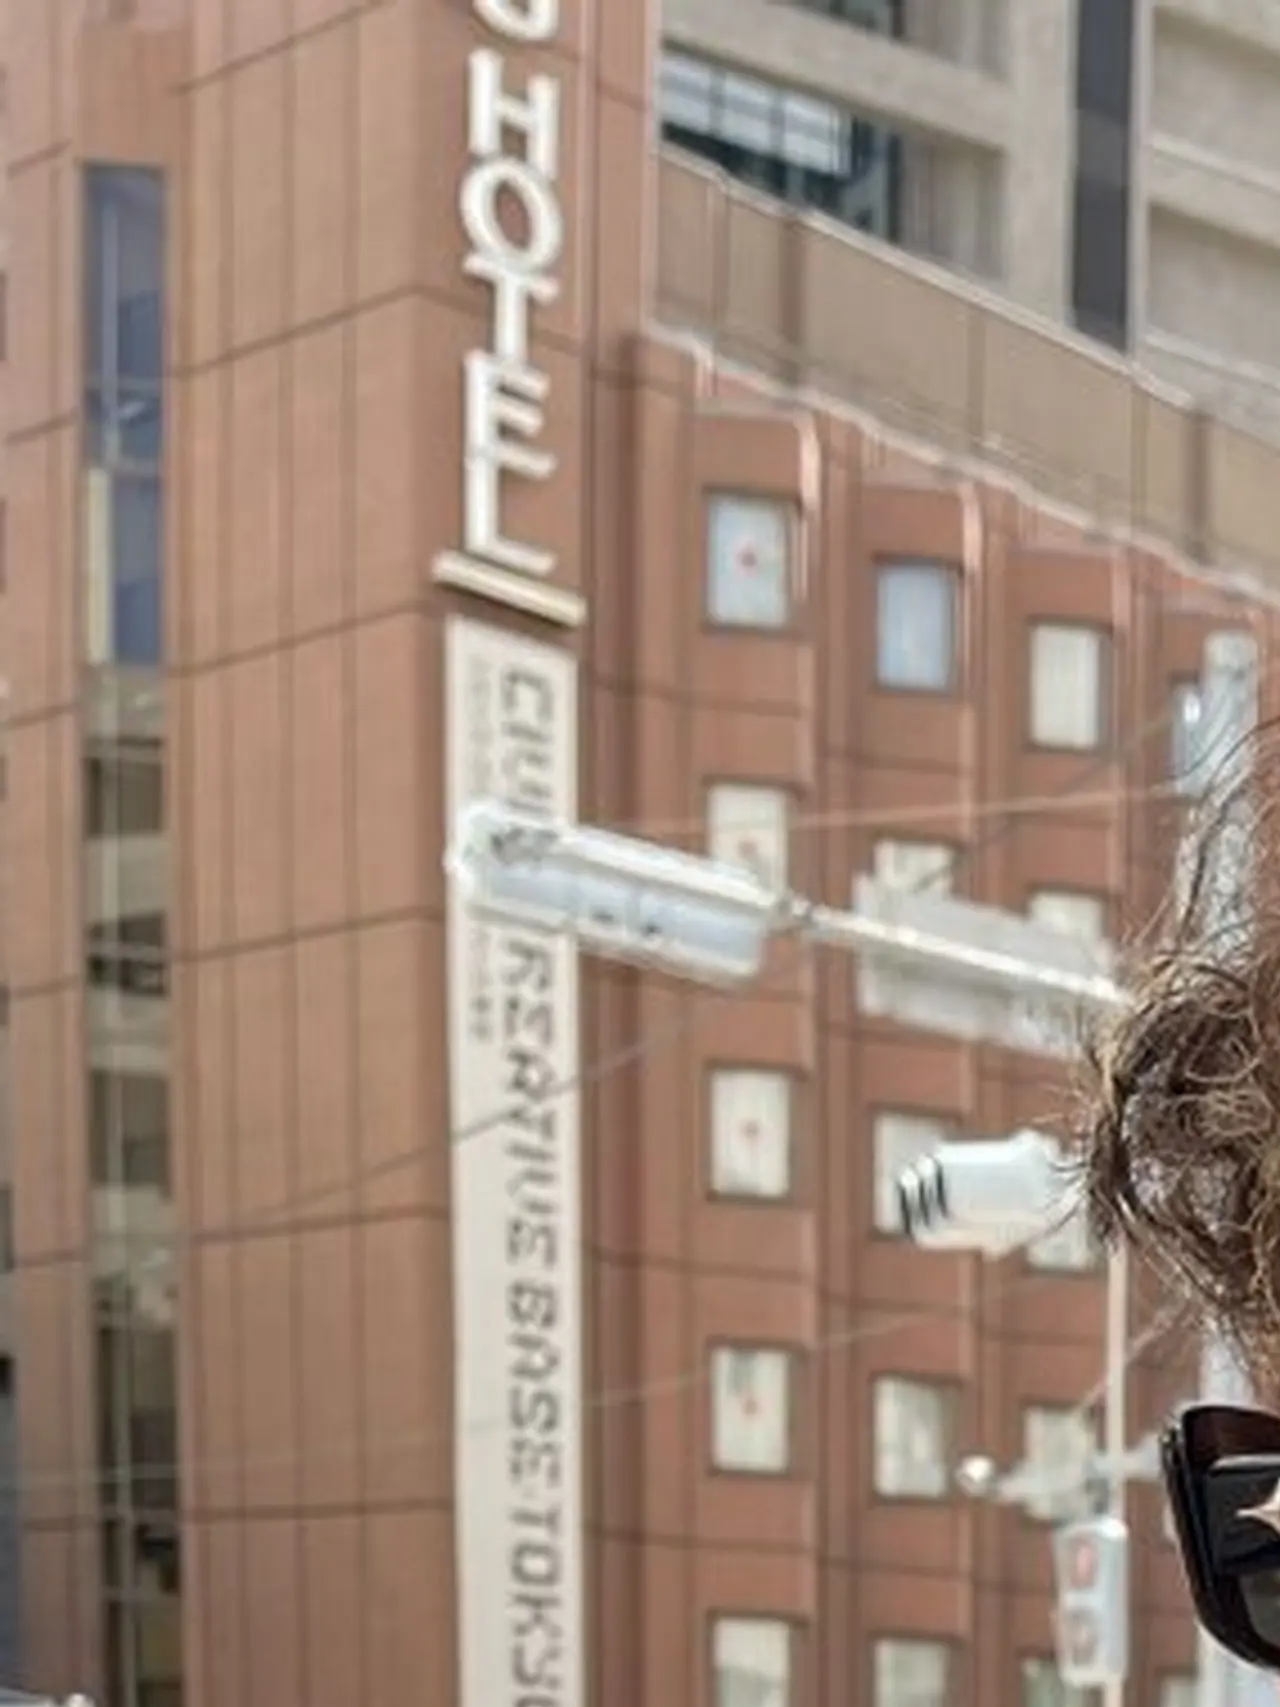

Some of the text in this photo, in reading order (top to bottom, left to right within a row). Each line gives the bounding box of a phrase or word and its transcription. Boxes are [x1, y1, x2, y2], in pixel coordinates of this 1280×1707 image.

[459, 47, 564, 574] HOTEL
[503, 936, 558, 1271] REATIVE
[507, 1279, 561, 1488] BASE
